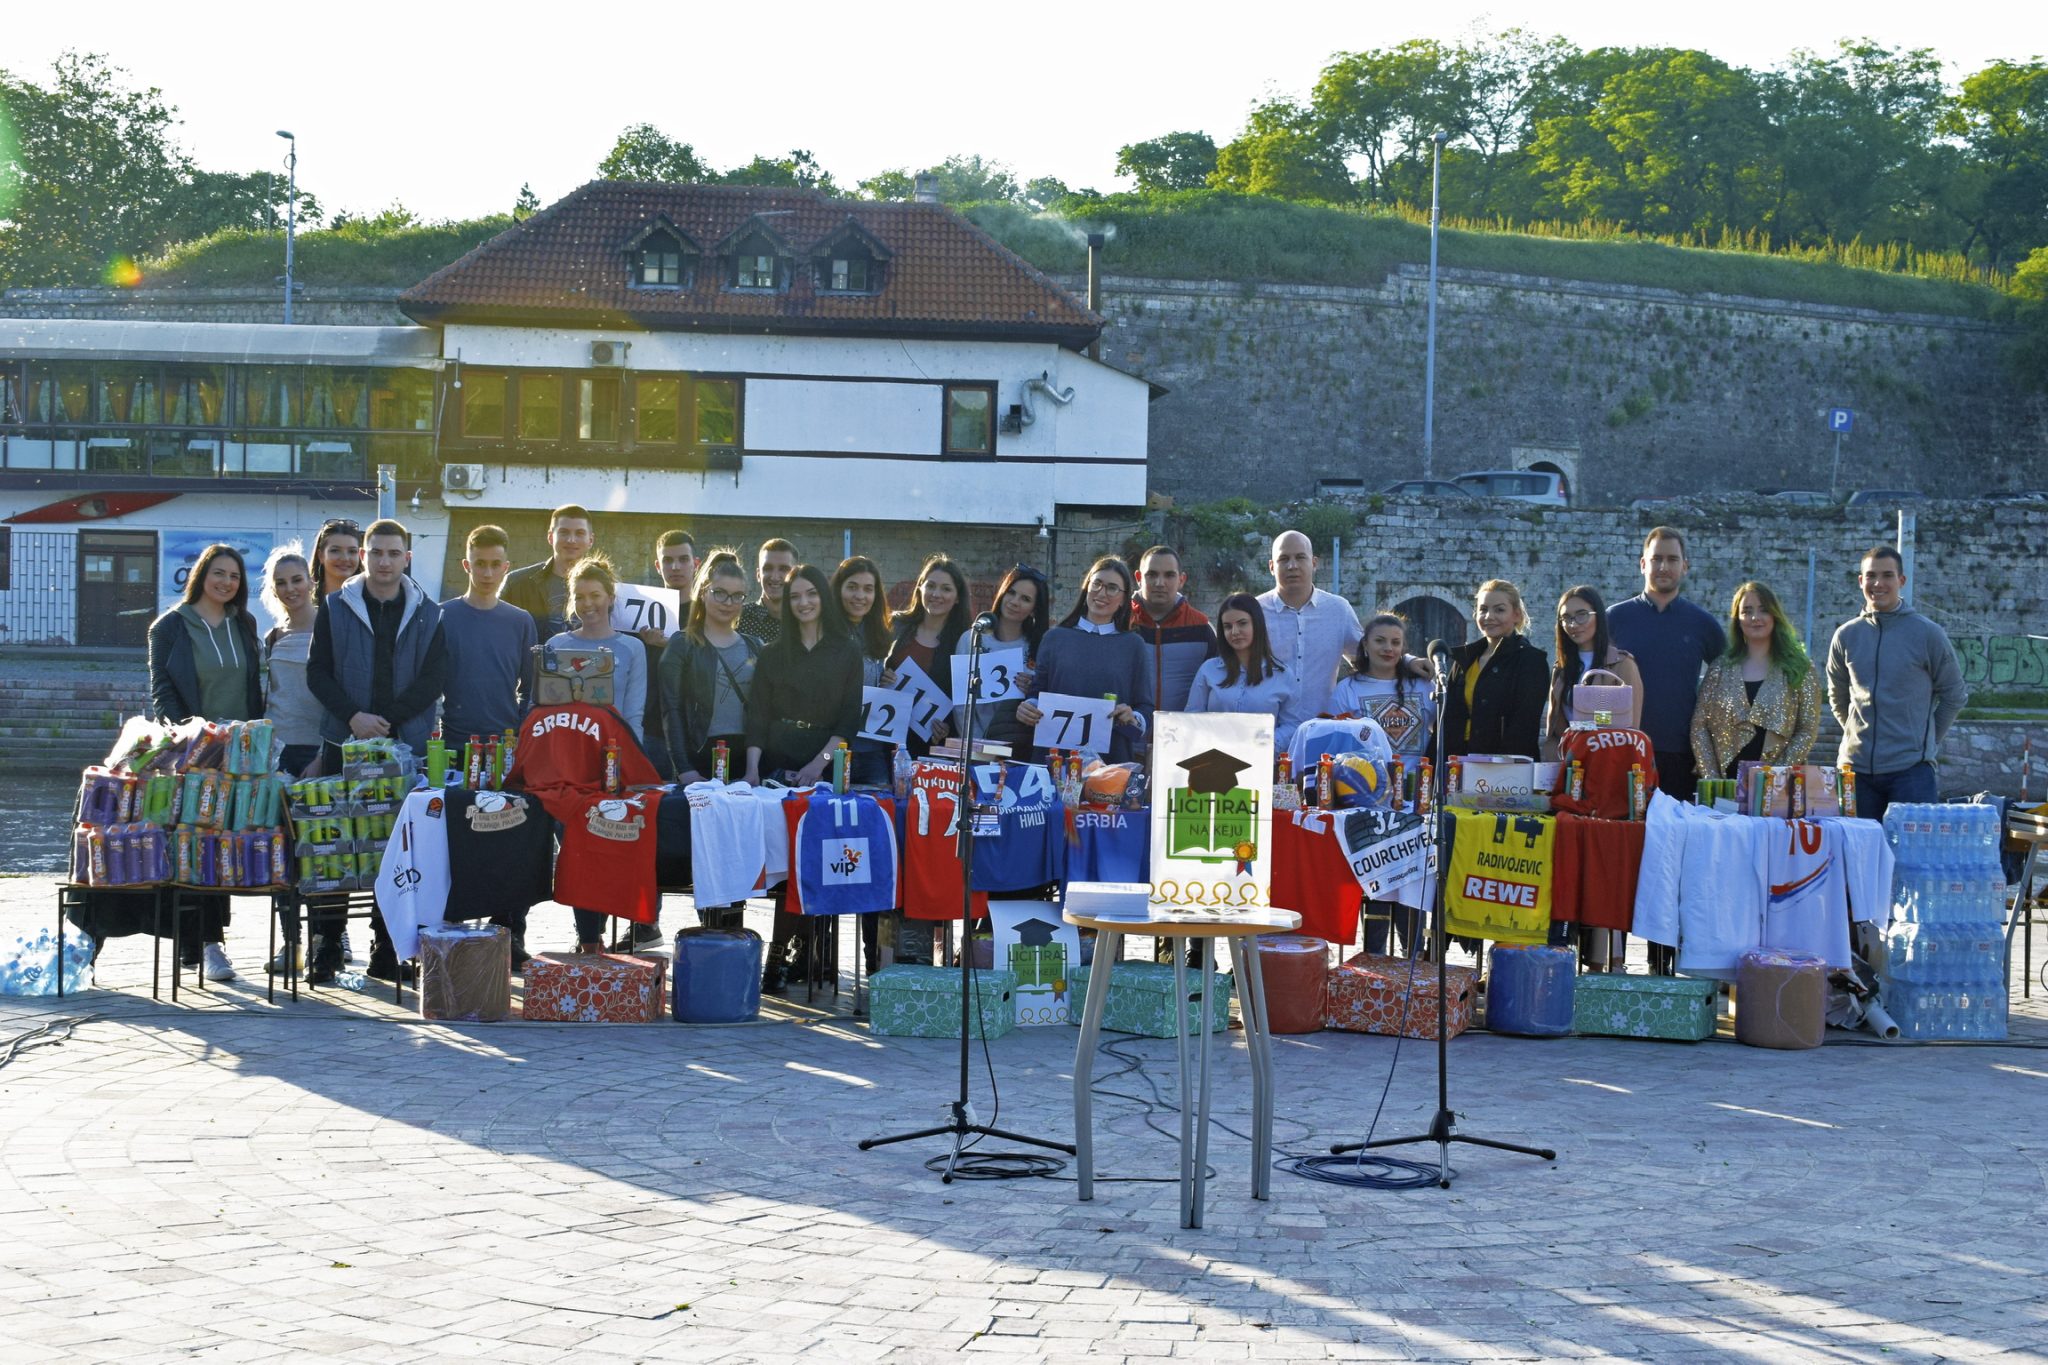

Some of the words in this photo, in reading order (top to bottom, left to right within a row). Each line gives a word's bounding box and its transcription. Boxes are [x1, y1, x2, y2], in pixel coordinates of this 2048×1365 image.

[1834, 411, 1847, 427] P
[625, 598, 667, 630] 70
[531, 712, 600, 742] SRBIJA
[860, 701, 897, 737] 12
[1051, 709, 1093, 747] 71
[469, 754, 480, 782] tube
[917, 776, 960, 793] IVKOVI
[973, 764, 1056, 808] 54
[1320, 772, 1328, 800] tube
[1420, 772, 1430, 802] tube
[1475, 778, 1529, 796] BIANCO
[827, 798, 860, 827] 11
[1169, 798, 1259, 815] LICITIRAJ
[1019, 811, 1046, 829] НИШ
[1075, 812, 1128, 829] SERBIA
[1189, 824, 1209, 836] NA
[1214, 824, 1243, 838] KEJU
[830, 855, 857, 877] vip
[1477, 851, 1543, 876] RADIVOJEVIC
[1465, 876, 1536, 907] REWE
[1008, 949, 1067, 961] LICITIRAJ
